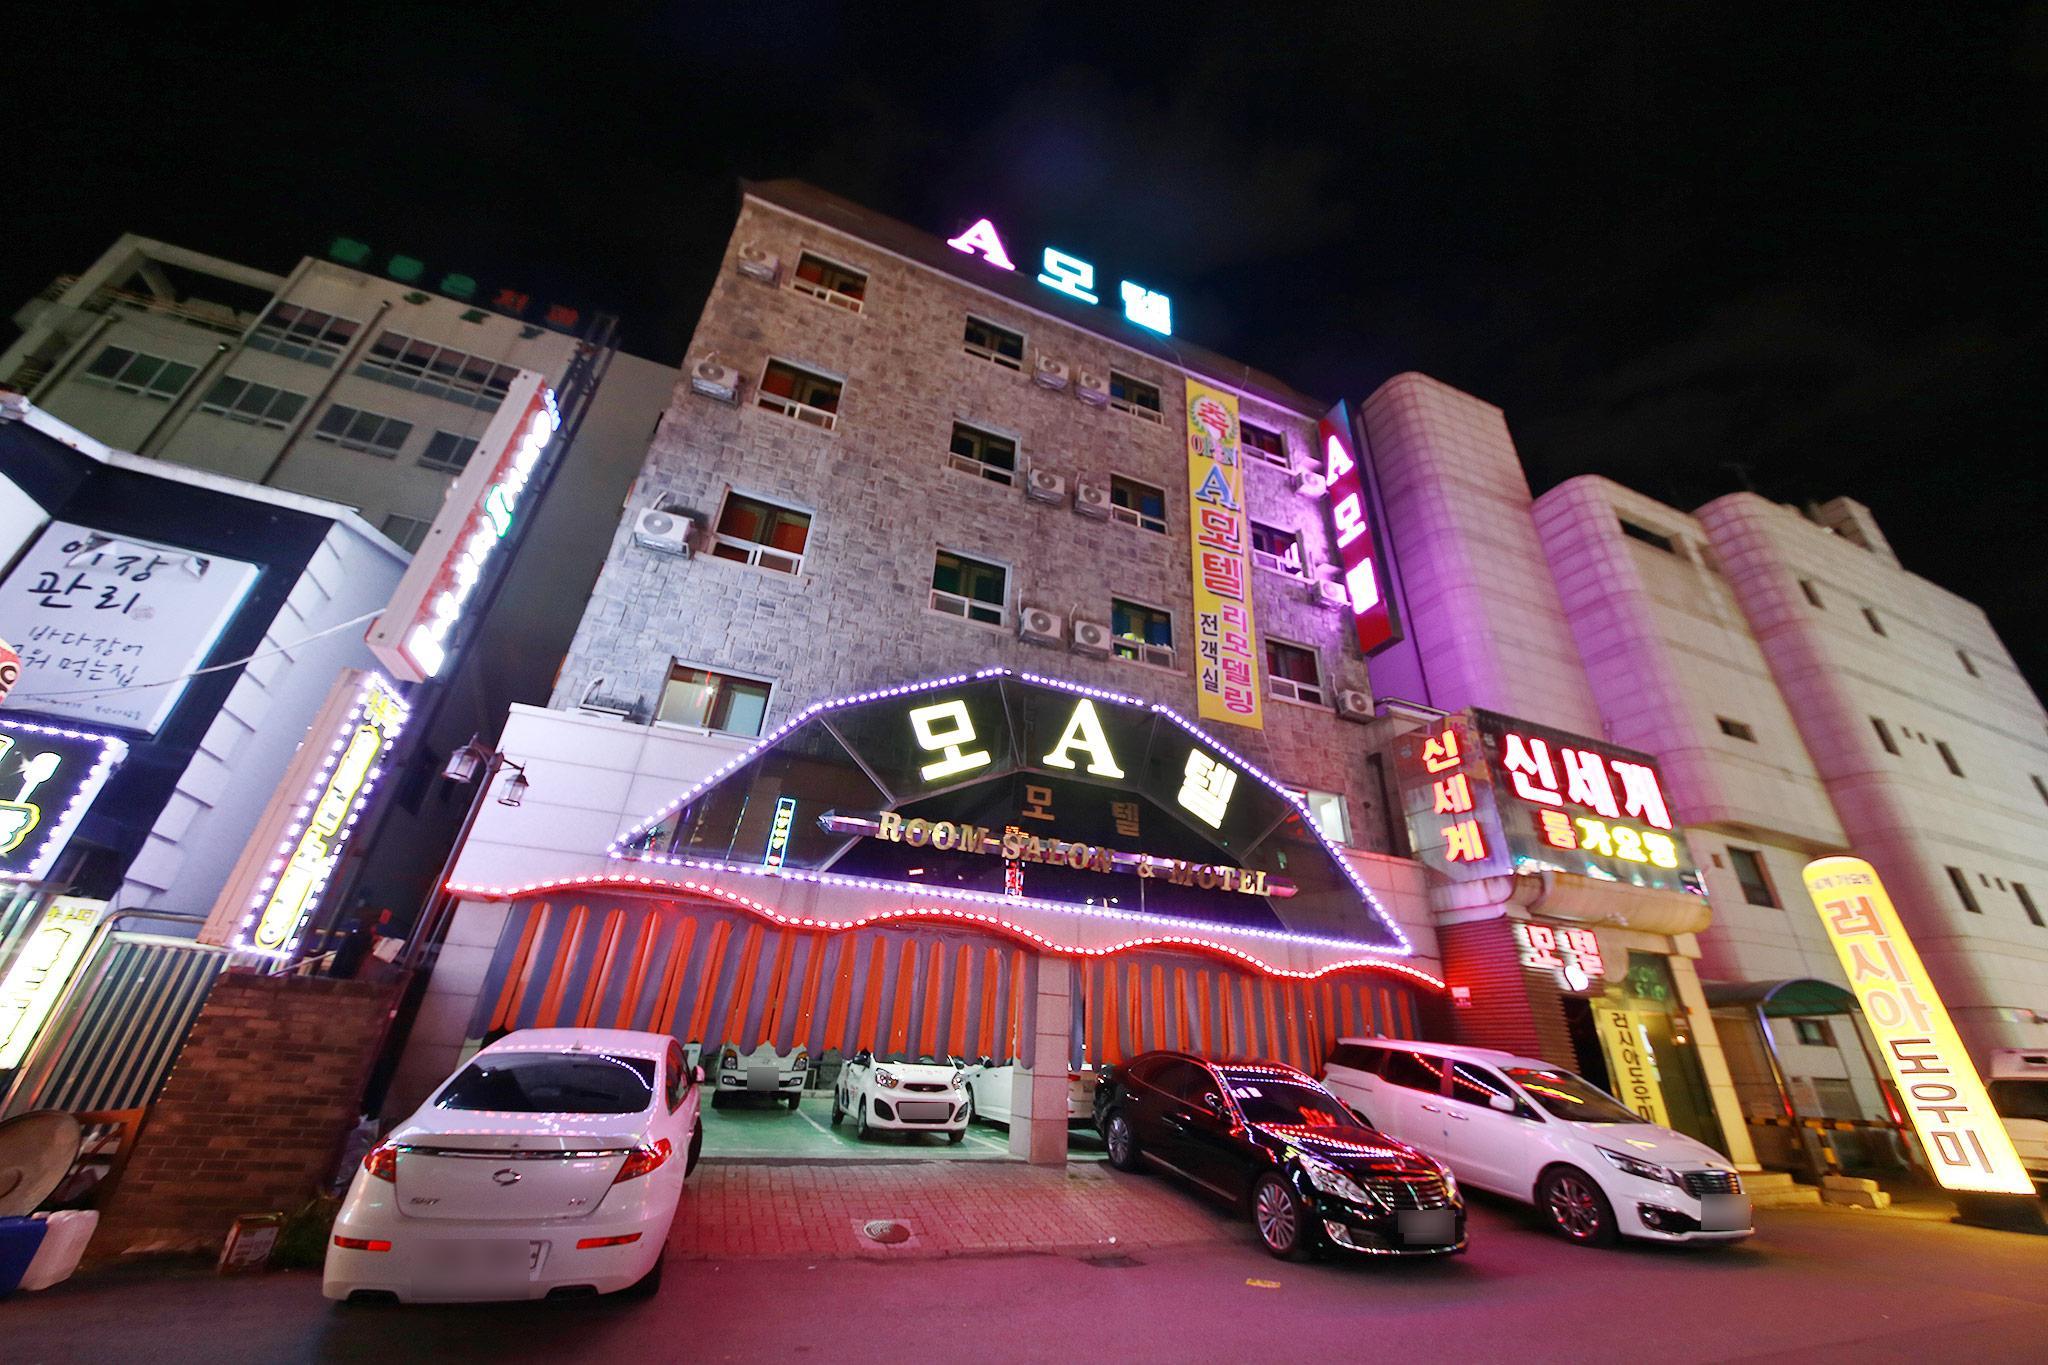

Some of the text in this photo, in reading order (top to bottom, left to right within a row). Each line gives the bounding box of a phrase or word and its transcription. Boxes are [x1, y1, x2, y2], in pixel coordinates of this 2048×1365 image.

[28, 625, 144, 656] 바다장어
[1200, 612, 1219, 694] 전객실
[1222, 604, 1254, 714] 리모델링
[1422, 729, 1486, 863] 신세계
[1503, 733, 1673, 830] 신세계
[874, 810, 1272, 897] ROOM SALON & MOTEL
[1514, 923, 1605, 976] 모텔
